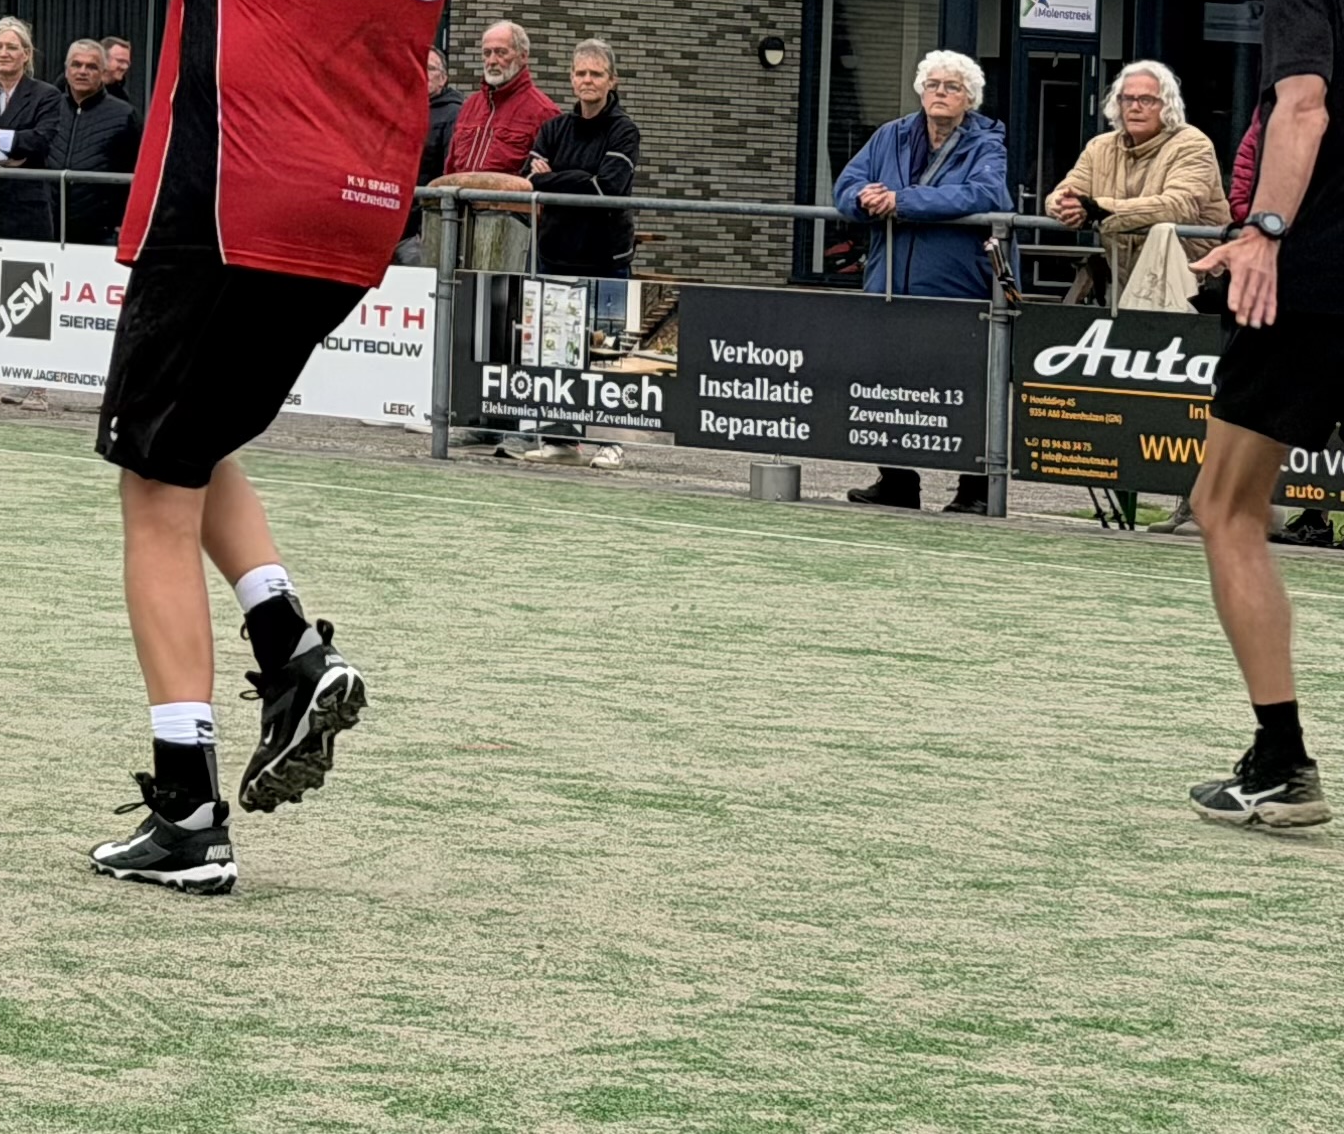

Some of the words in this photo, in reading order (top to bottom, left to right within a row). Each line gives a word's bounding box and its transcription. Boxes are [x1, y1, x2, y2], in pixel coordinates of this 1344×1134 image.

[1038, 7, 1092, 21] Molenstreek
[59, 314, 117, 332] SIERBE
[321, 336, 423, 358] OUTBOUW
[709, 339, 804, 373] Verkoop
[481, 364, 576, 405] Flonk
[580, 372, 663, 413] Tech
[699, 374, 813, 405] Installatie
[849, 382, 941, 404] Oudestreek
[944, 389, 964, 406] 13
[383, 402, 416, 417] LEEK
[482, 400, 538, 418] Elektronica
[540, 405, 594, 423] Vakhandel
[596, 410, 662, 428] Zevenhuizen
[848, 405, 949, 428] Zevenhuizen
[700, 409, 811, 441] Reparatie
[848, 429, 889, 447] 0594
[901, 432, 963, 453] 631217
[1285, 484, 1325, 500] auto
